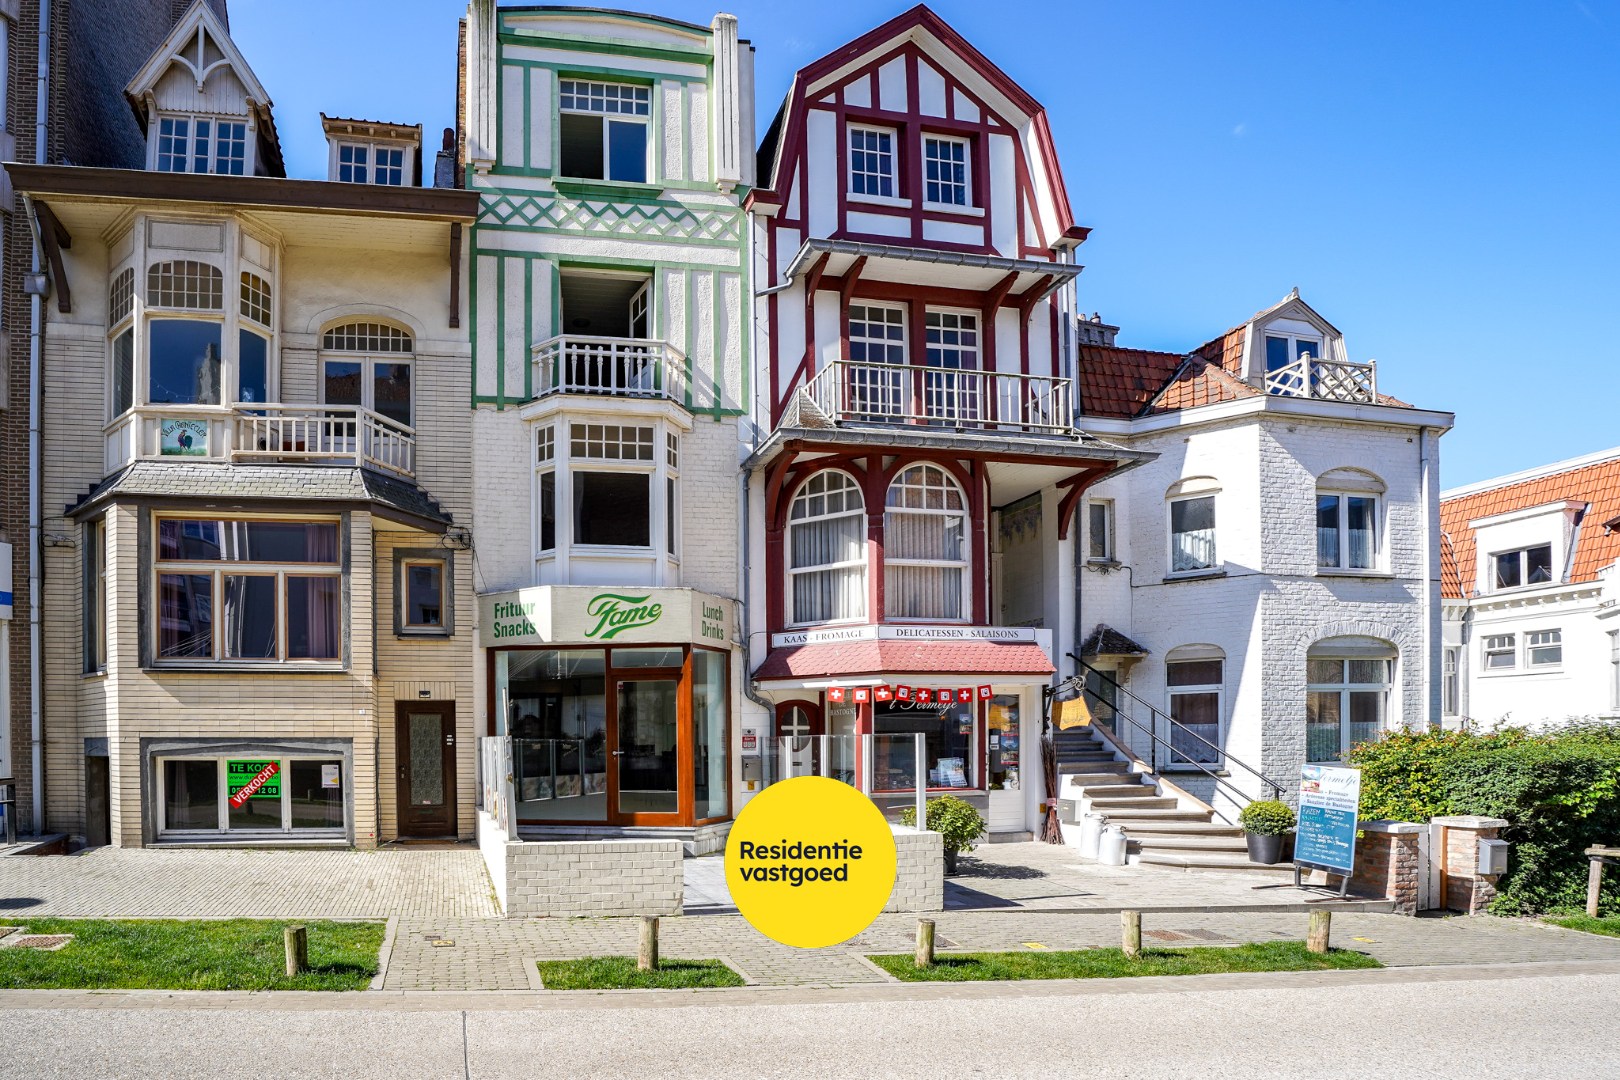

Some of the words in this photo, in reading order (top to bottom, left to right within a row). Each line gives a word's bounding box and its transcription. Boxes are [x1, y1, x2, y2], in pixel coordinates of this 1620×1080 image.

[494, 601, 536, 619] Frituur
[584, 593, 663, 639] Fame
[702, 601, 724, 622] Lunch
[493, 619, 537, 638] Snacks
[701, 620, 724, 640] Drinks
[784, 635, 808, 643] KAAS
[815, 630, 864, 641] FROMAGE
[896, 628, 964, 637] DELICATESSEN
[970, 628, 1019, 638] SALAISONS
[231, 764, 244, 772] TE
[233, 764, 275, 803] VERKOCHT
